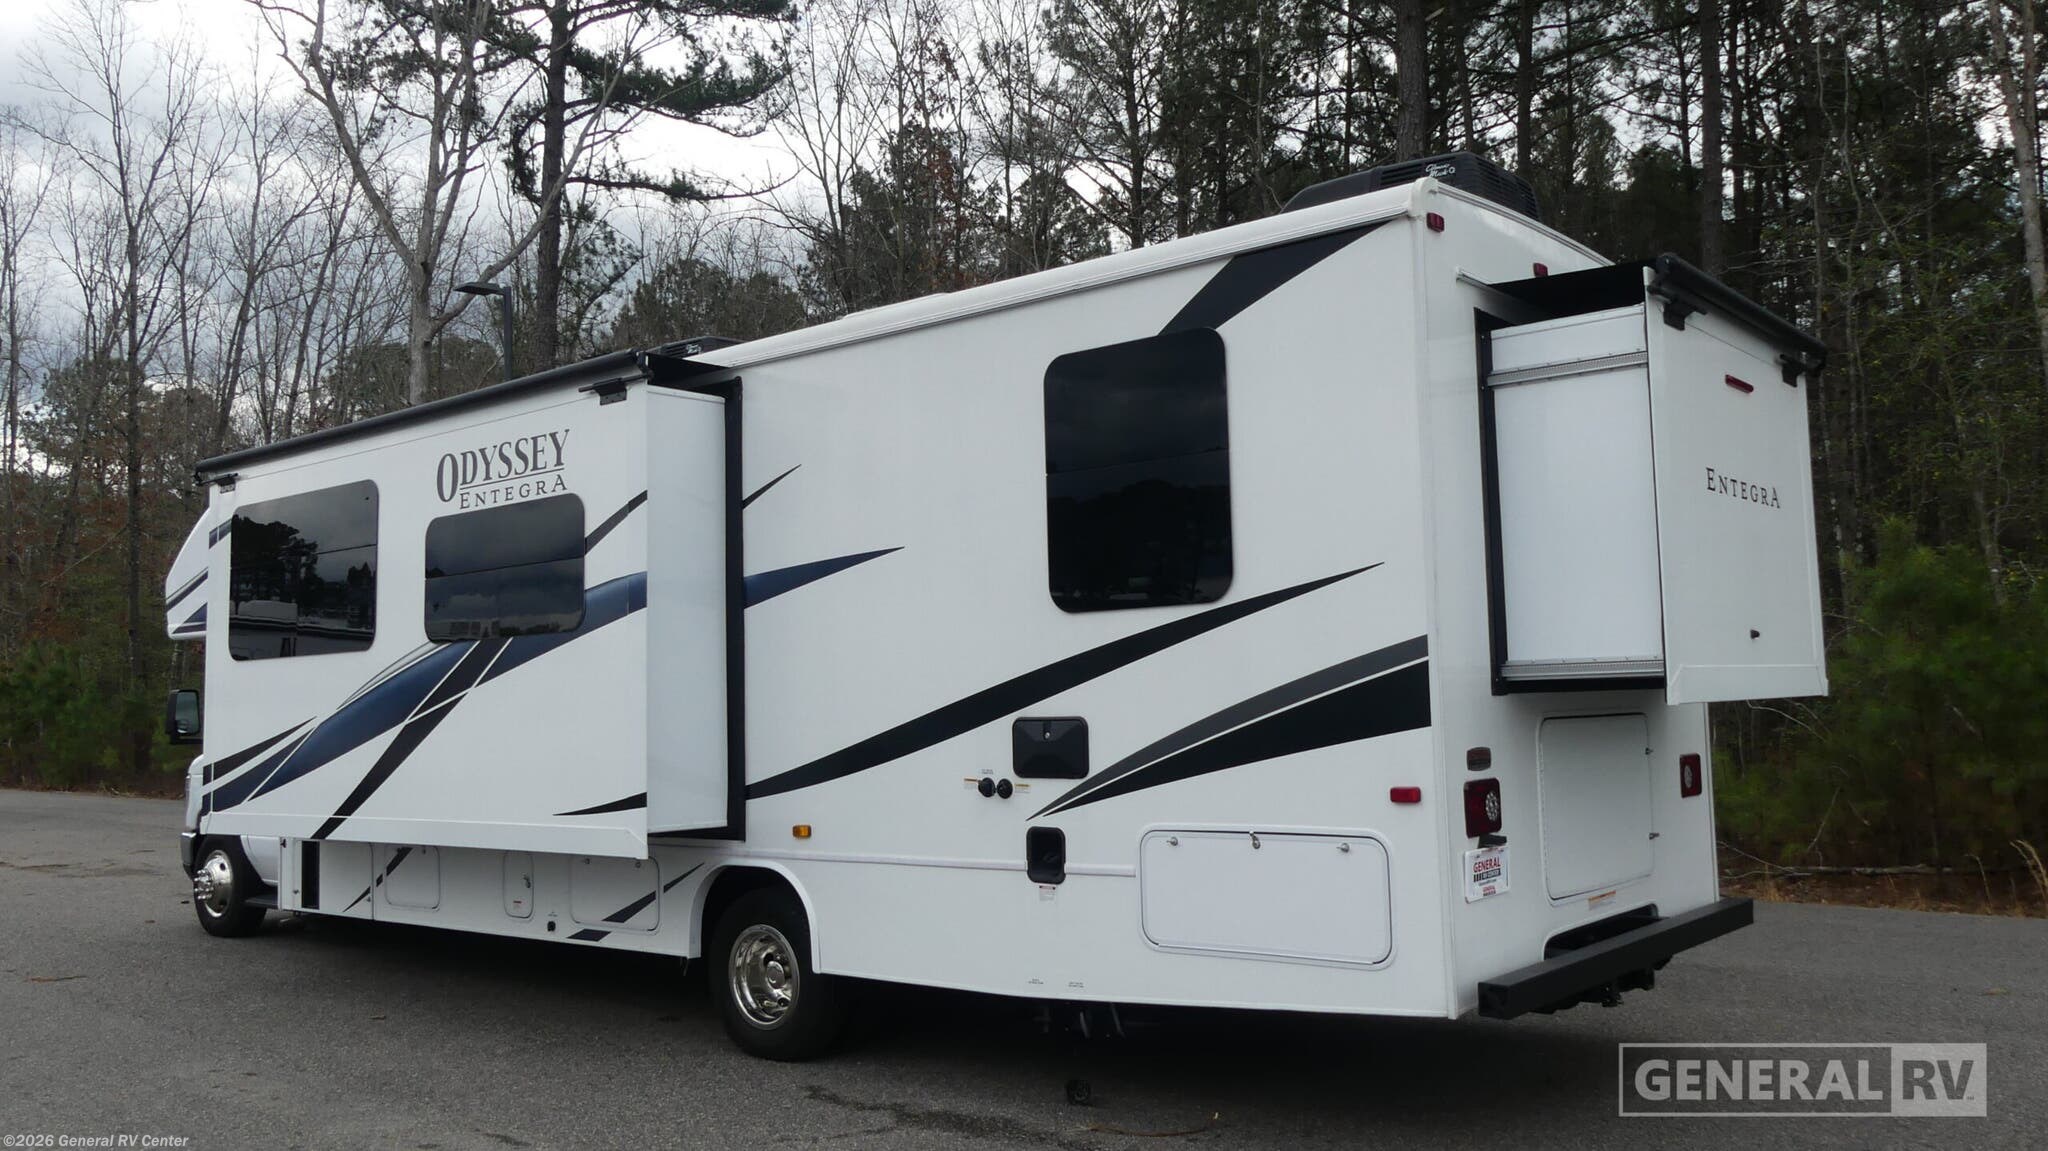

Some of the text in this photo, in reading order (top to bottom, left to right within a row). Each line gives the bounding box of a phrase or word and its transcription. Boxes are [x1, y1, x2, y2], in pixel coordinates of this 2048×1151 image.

[436, 429, 570, 502] ODYSSEY
[459, 474, 567, 509] ENTEGRA
[1706, 467, 1781, 509] ENTEGRA
[1473, 857, 1501, 873] GENERAL
